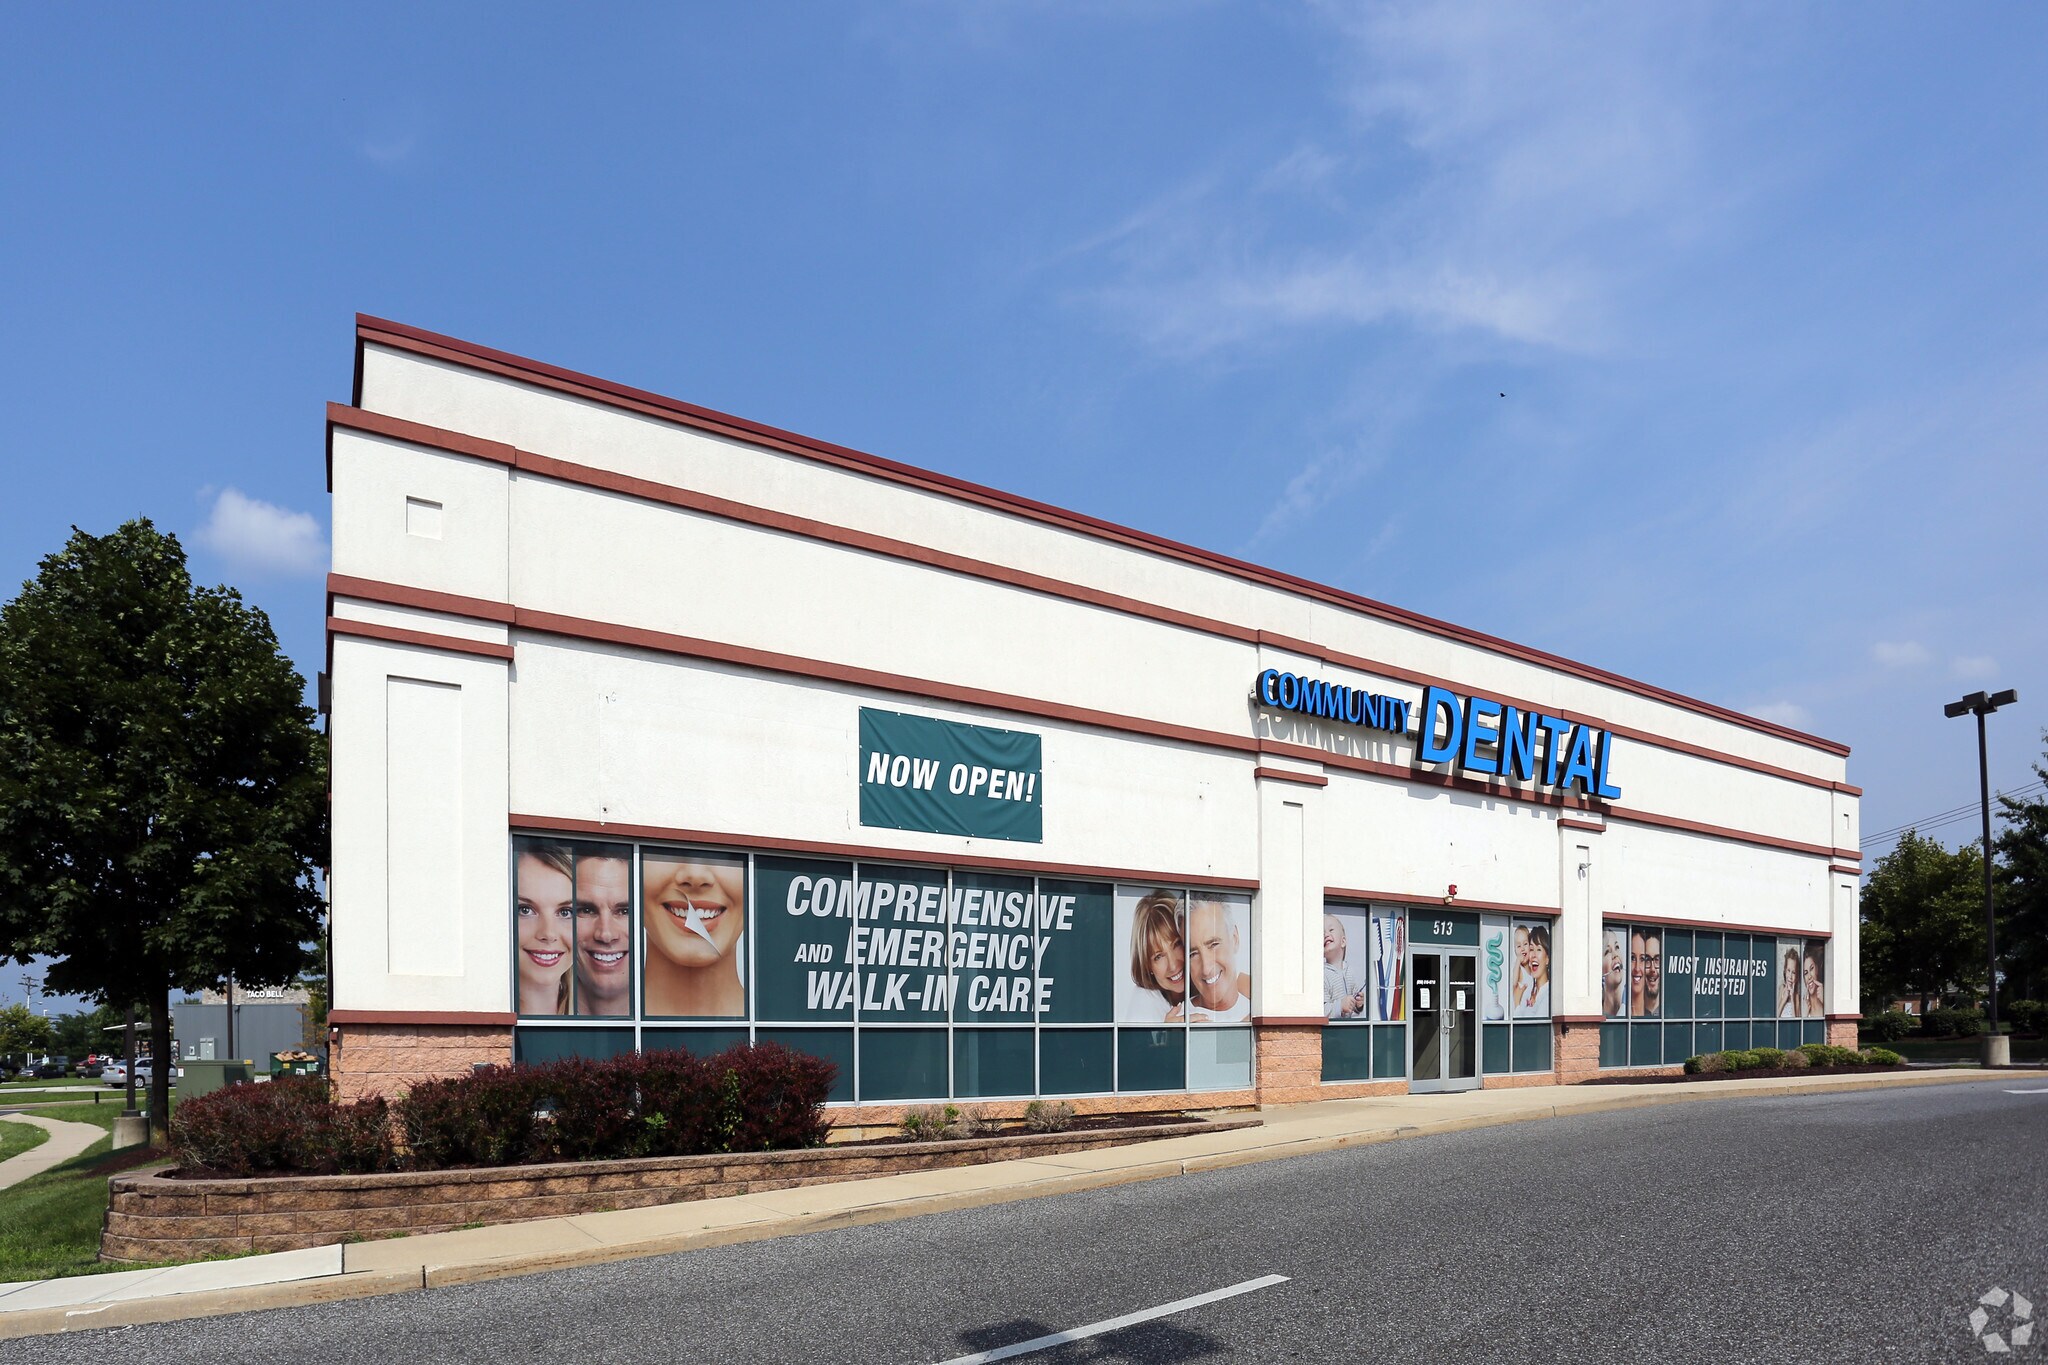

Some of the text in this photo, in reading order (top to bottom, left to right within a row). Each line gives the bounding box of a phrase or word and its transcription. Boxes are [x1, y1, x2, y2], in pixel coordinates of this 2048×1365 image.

[1258, 669, 1622, 799] COMMUNITY DENTAL
[867, 752, 1036, 802] NOW OPEN!
[786, 875, 1076, 930] COMPREHENSIVE
[794, 926, 1051, 971] AND EMERGENCY
[1433, 920, 1453, 936] 513
[1668, 955, 1767, 977] MOST INSURANCES
[1694, 977, 1746, 996] ACCEPTED
[247, 990, 284, 998] TACO BELL
[807, 970, 1054, 1013] WALK-IN CARE
